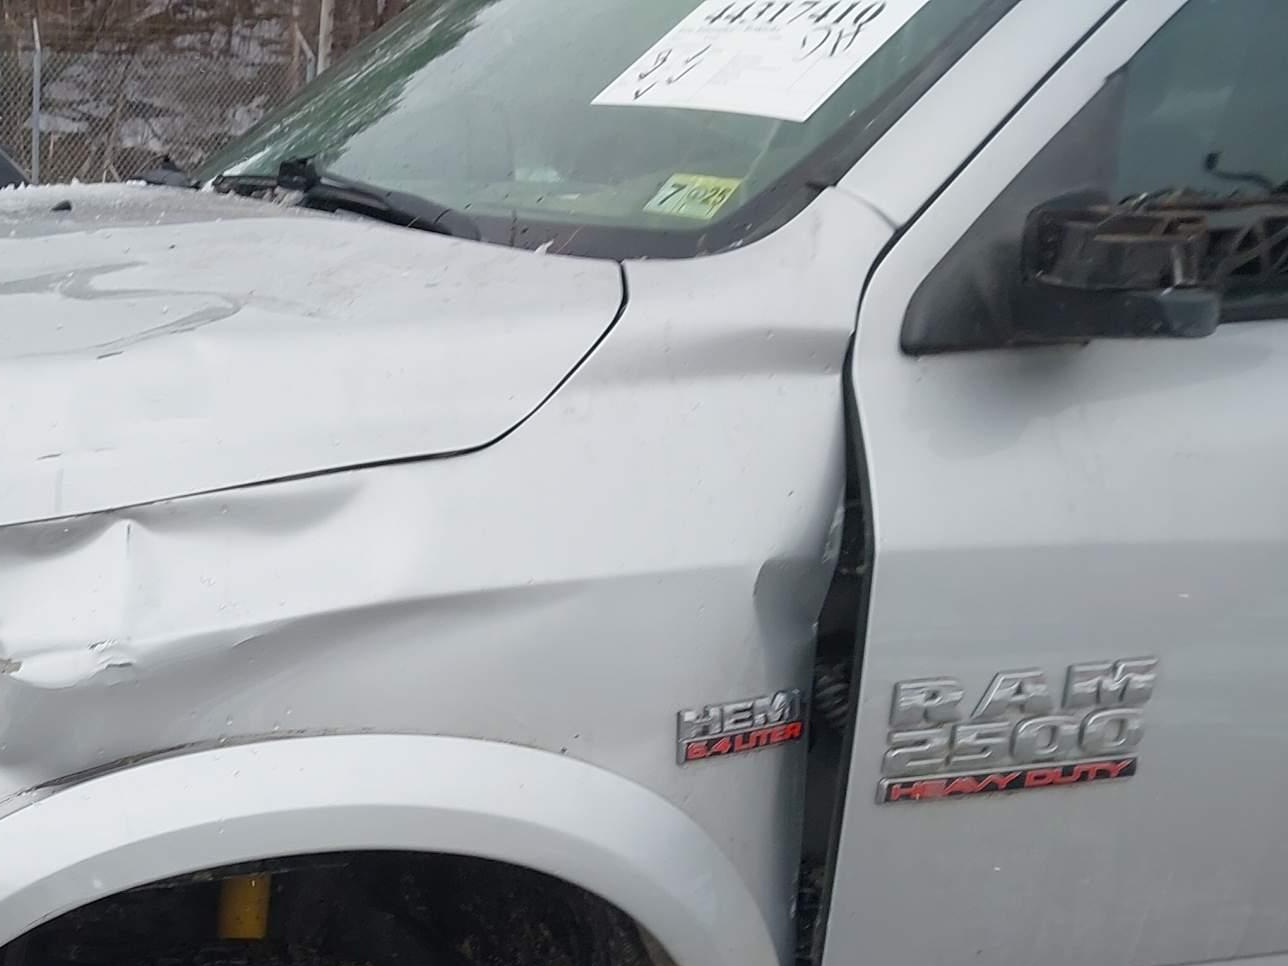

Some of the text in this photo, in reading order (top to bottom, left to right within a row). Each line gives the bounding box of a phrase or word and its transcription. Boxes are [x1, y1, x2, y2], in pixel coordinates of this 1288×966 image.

[889, 657, 1158, 729] RAM
[880, 708, 1145, 775] 2500
[890, 757, 1132, 802] HEAVY DUTY
